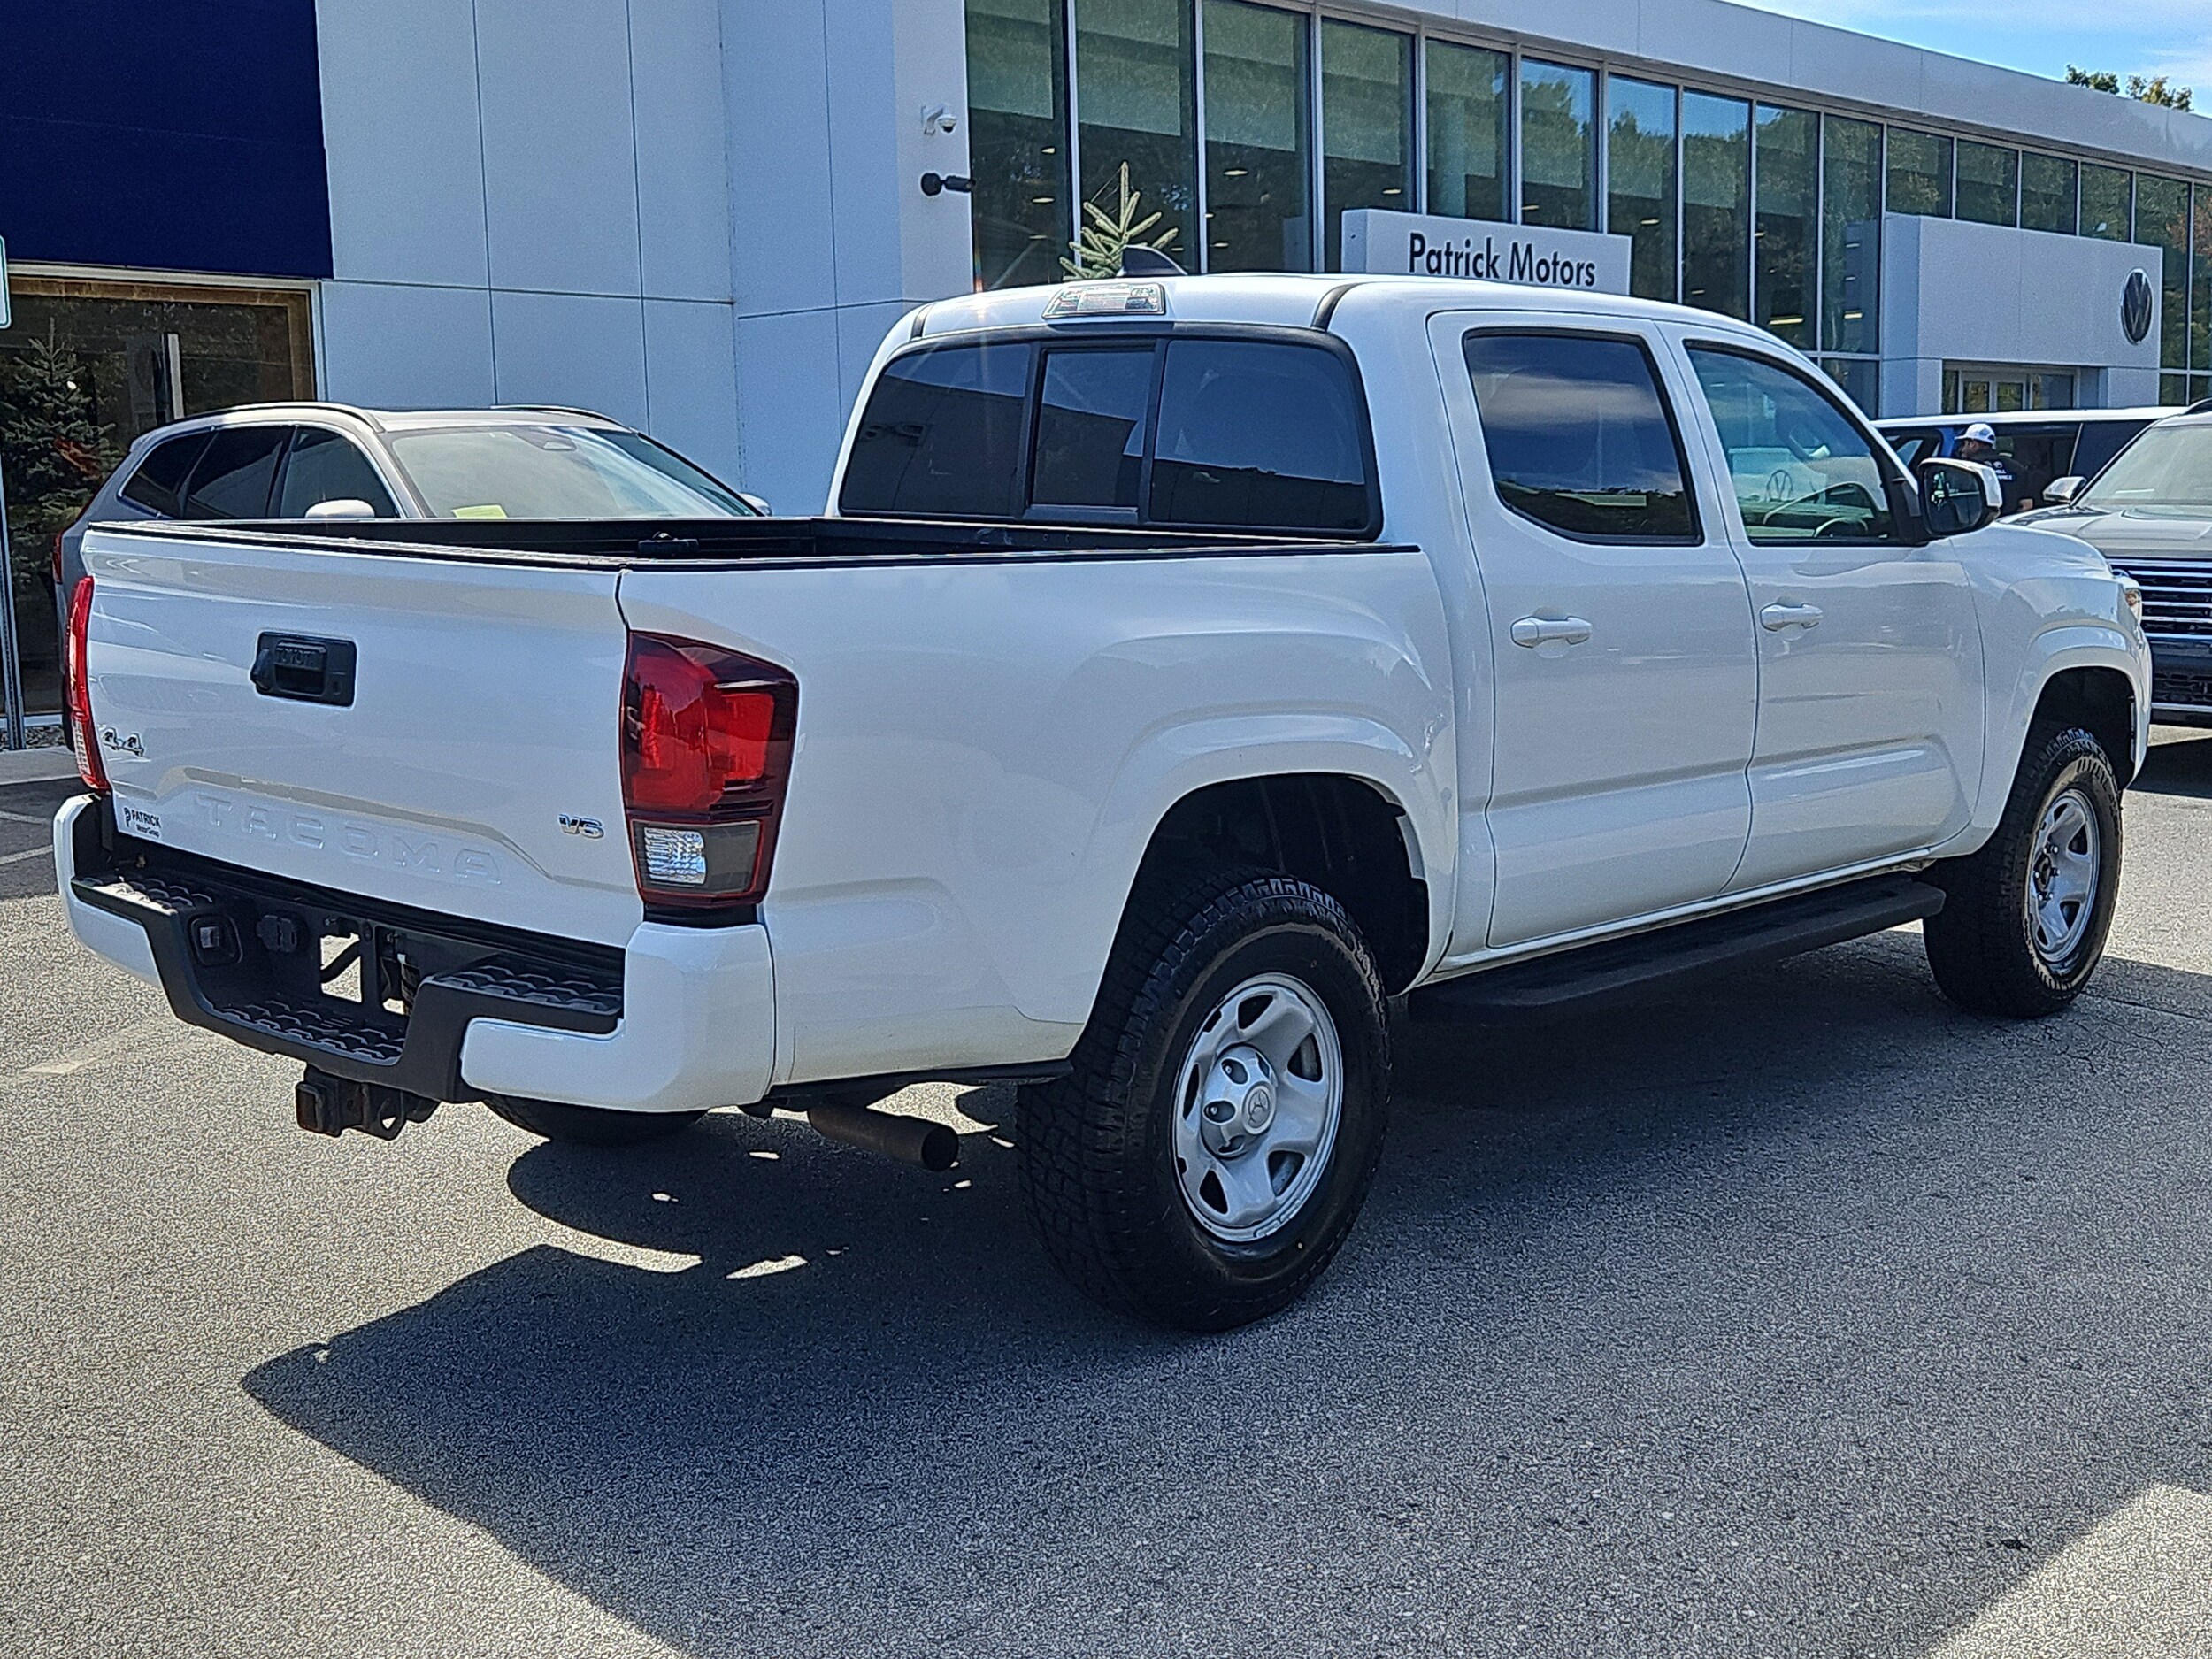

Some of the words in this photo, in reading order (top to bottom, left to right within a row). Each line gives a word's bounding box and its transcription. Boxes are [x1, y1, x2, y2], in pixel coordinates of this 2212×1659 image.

[1409, 233, 1501, 279] Patrick
[1509, 242, 1596, 287] Motors
[131, 810, 161, 828] PATRICK
[193, 793, 502, 885] TACOMA
[557, 813, 605, 839] V6
